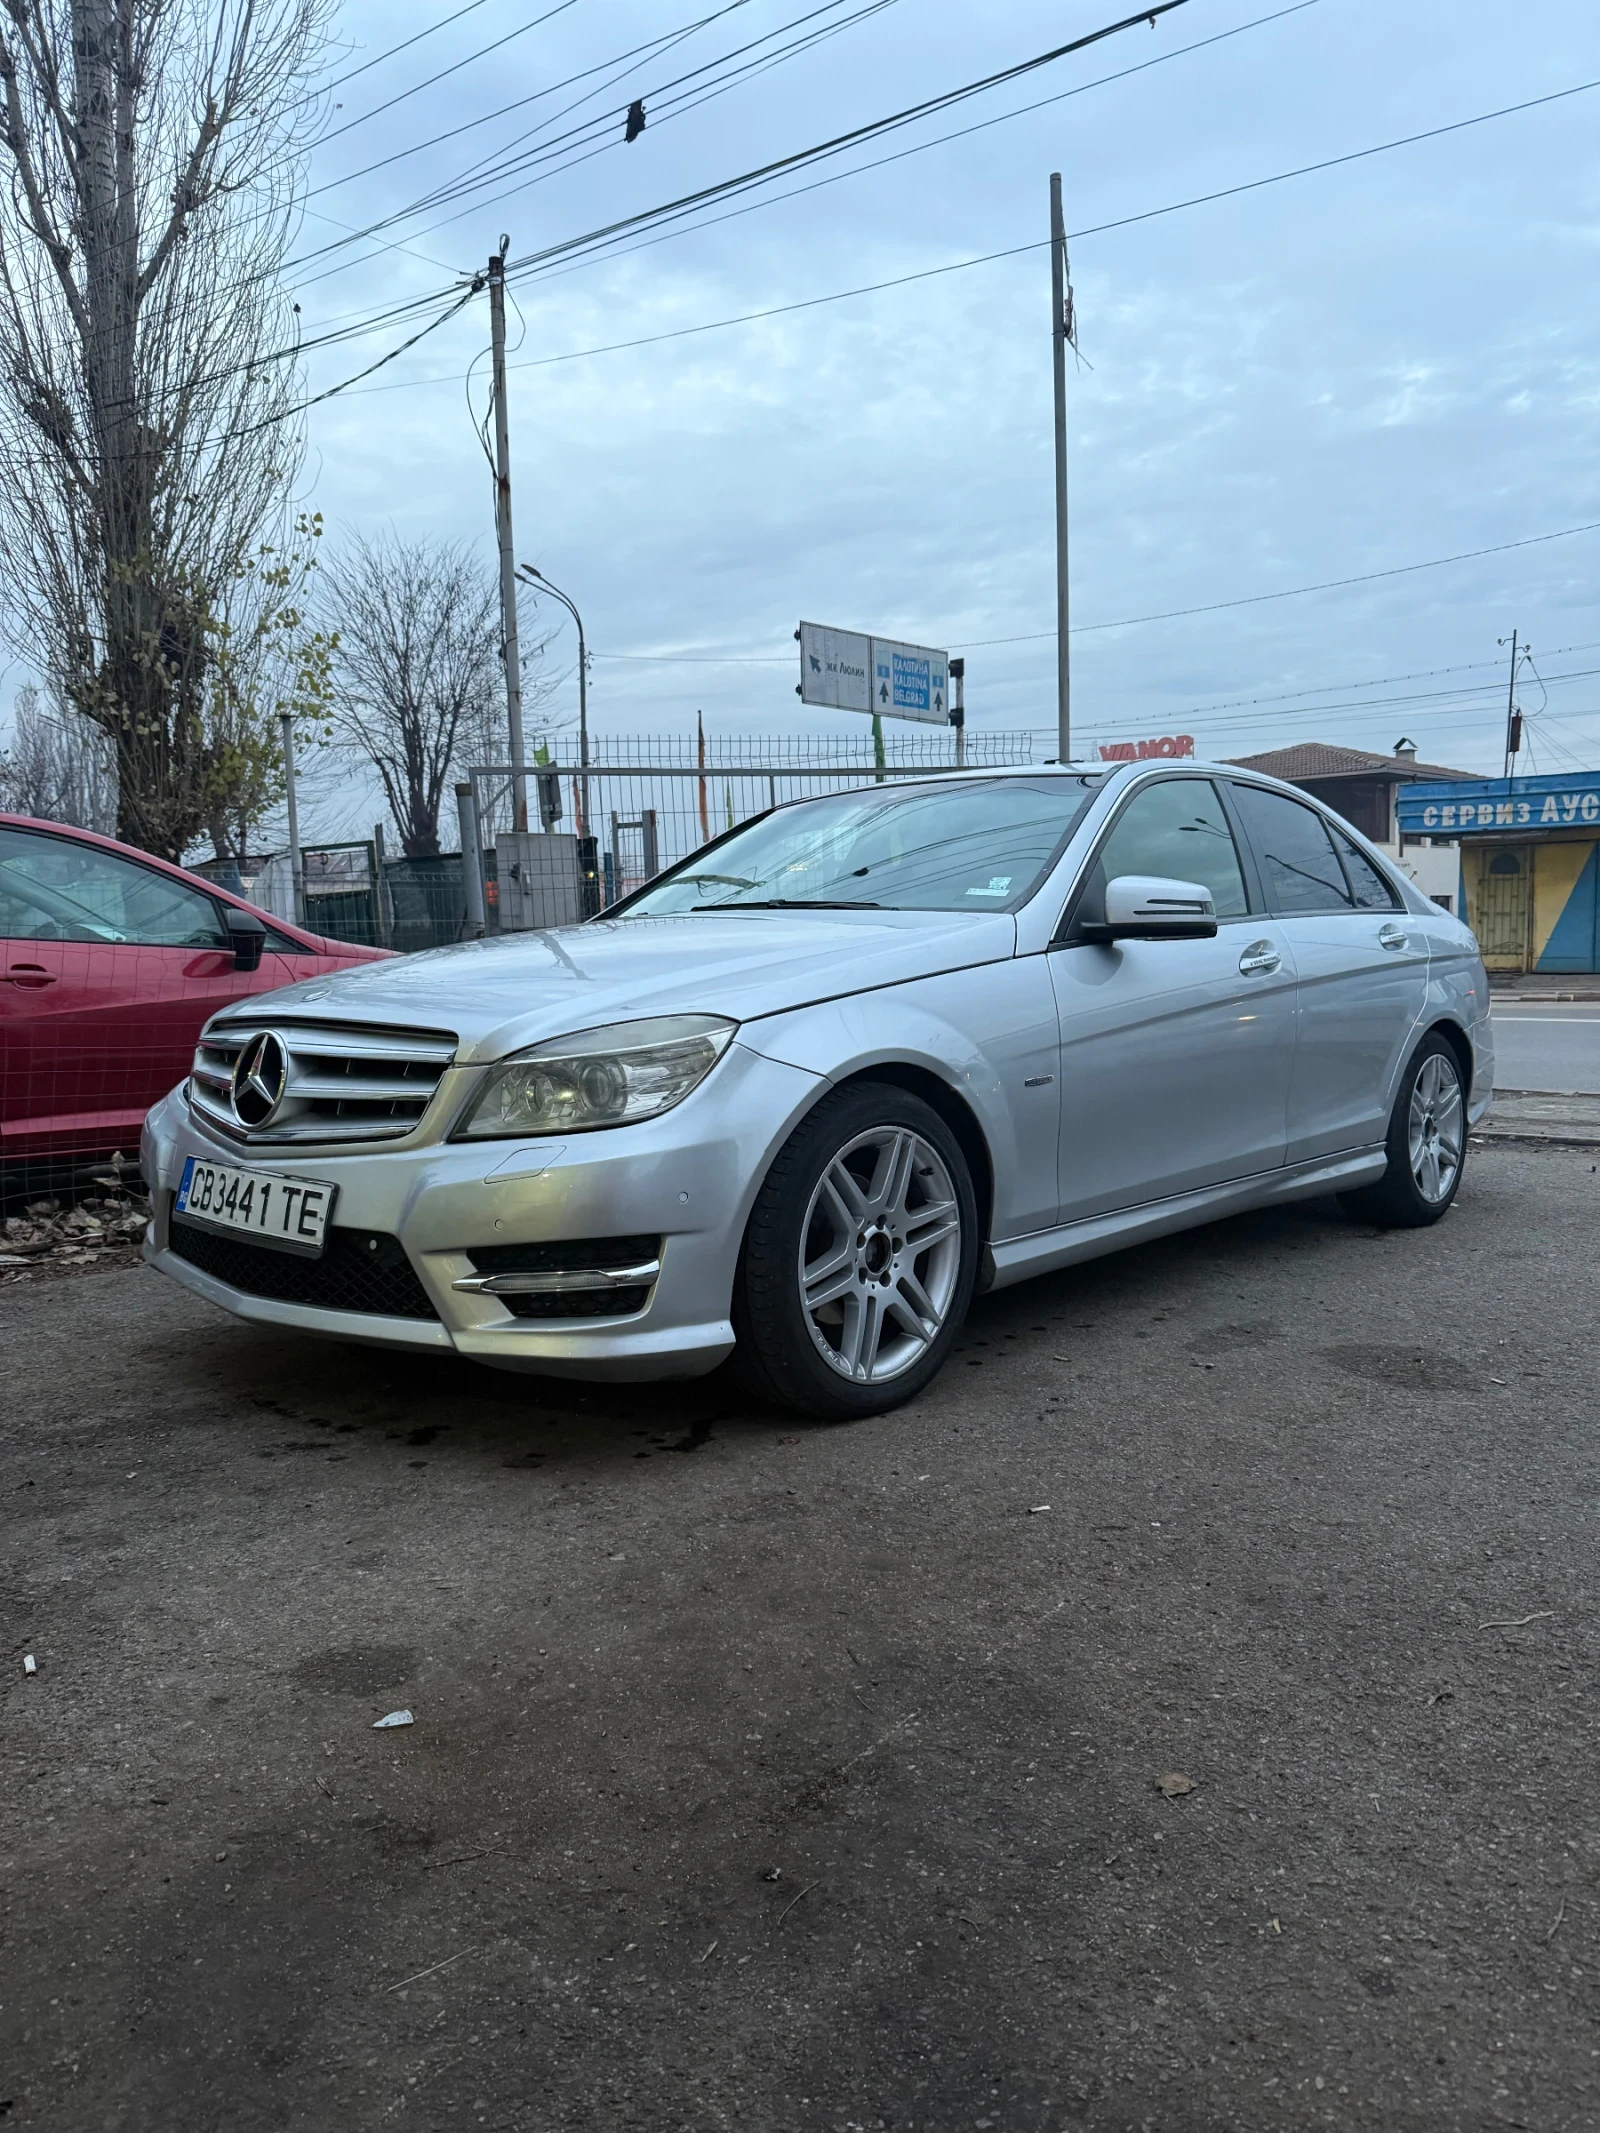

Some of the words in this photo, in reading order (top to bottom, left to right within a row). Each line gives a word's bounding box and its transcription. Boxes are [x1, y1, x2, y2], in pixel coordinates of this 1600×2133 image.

[840, 662, 864, 677] Люлин
[895, 690, 924, 704] BELGRAD
[1423, 802, 1531, 828] СЕРВИЗ
